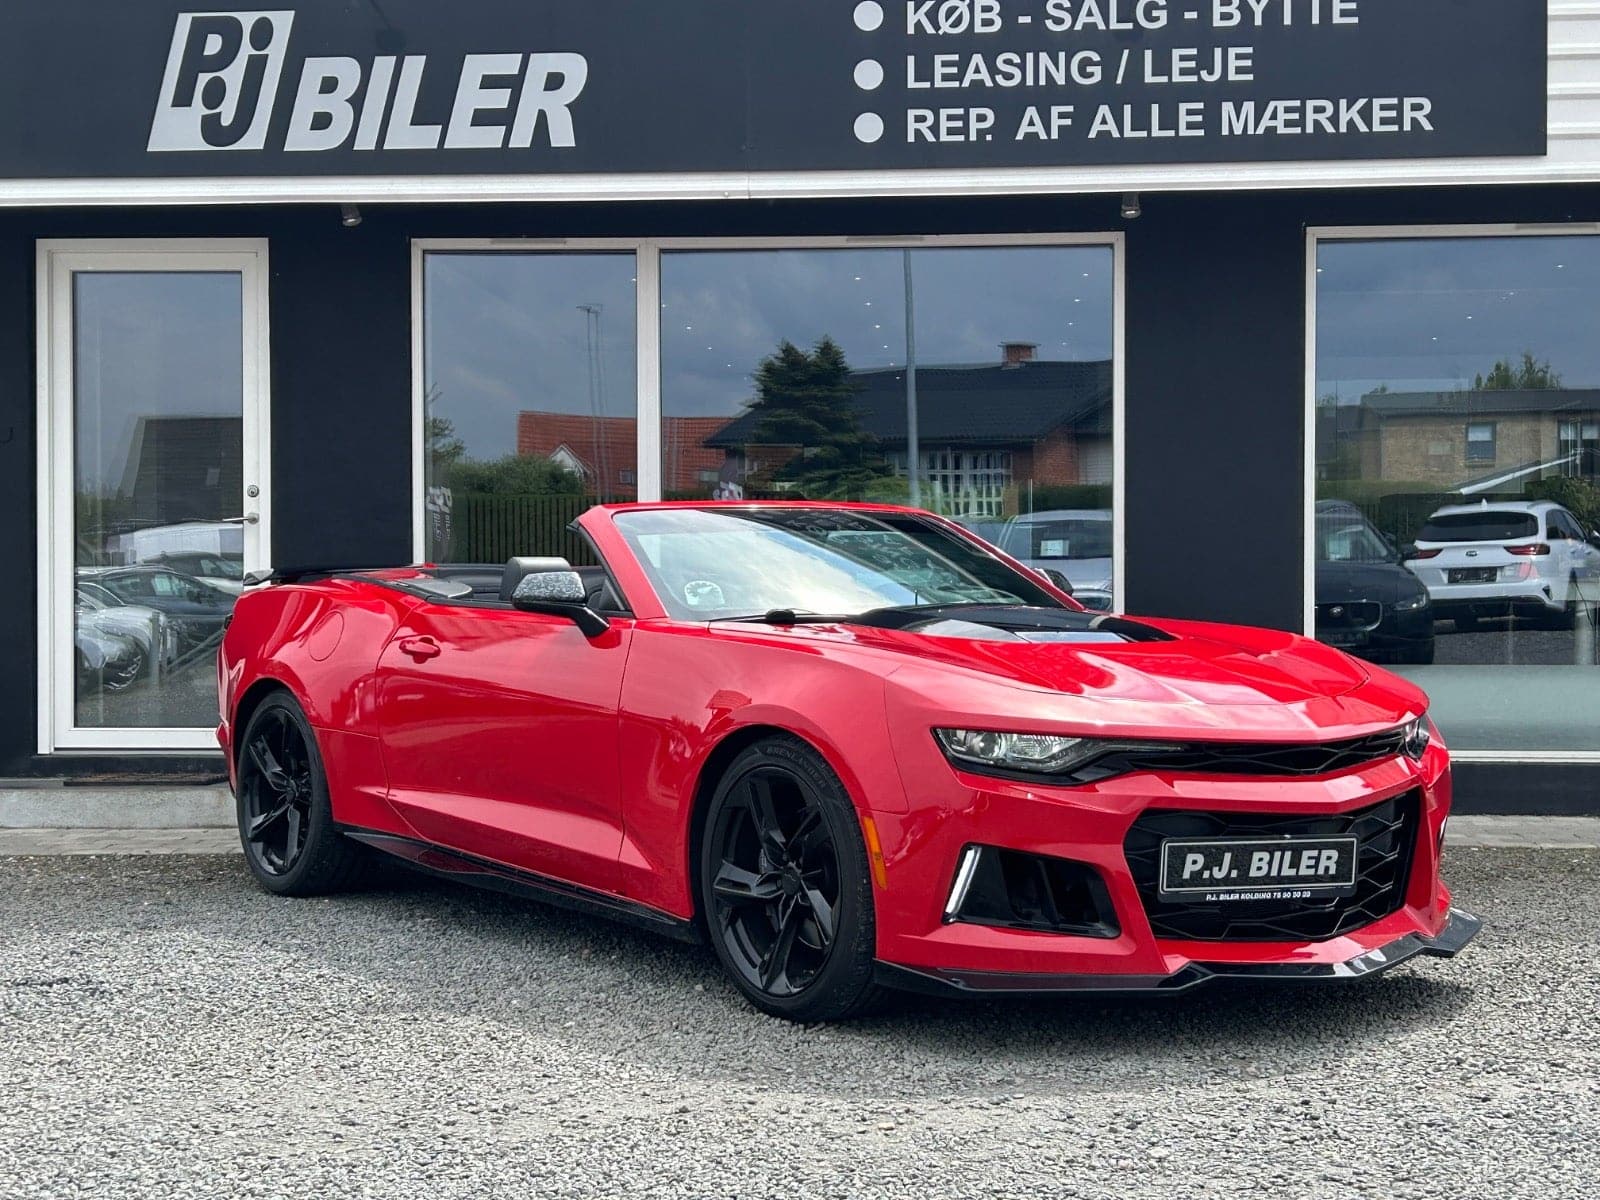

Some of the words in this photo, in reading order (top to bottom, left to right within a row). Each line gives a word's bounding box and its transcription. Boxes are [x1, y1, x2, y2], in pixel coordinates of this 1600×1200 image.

[907, 0, 1003, 36] KØB
[1044, 0, 1168, 32] SALG
[907, 51, 1102, 89] LEASING
[1143, 47, 1254, 84] LEJE
[284, 53, 588, 151] BILER
[907, 107, 995, 143] REP.
[1014, 105, 1074, 140] AF
[1087, 103, 1205, 139] ALLE
[1221, 97, 1434, 136] MÆRKER
[1182, 852, 1238, 880] P.J.
[1248, 849, 1339, 878] BILER
